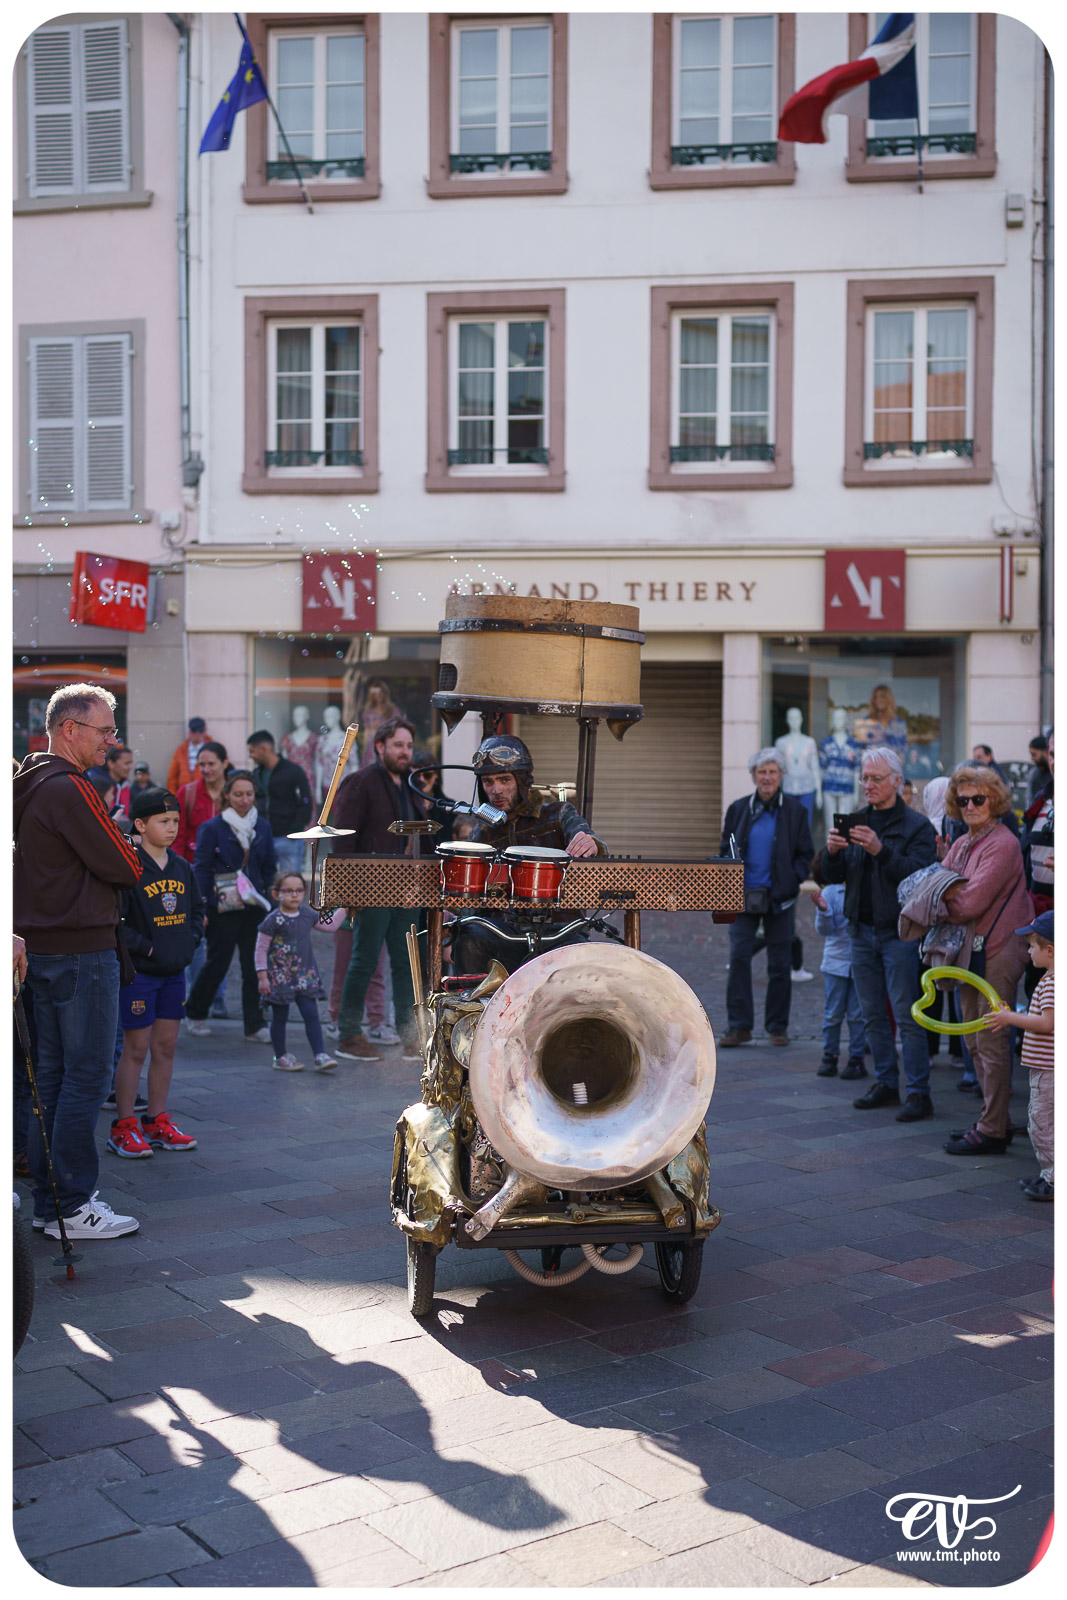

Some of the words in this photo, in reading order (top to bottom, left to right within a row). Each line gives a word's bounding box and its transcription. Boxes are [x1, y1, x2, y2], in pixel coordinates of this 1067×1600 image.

[99, 577, 147, 609] SFR
[624, 582, 757, 601] THIERY
[144, 879, 185, 898] NYPD
